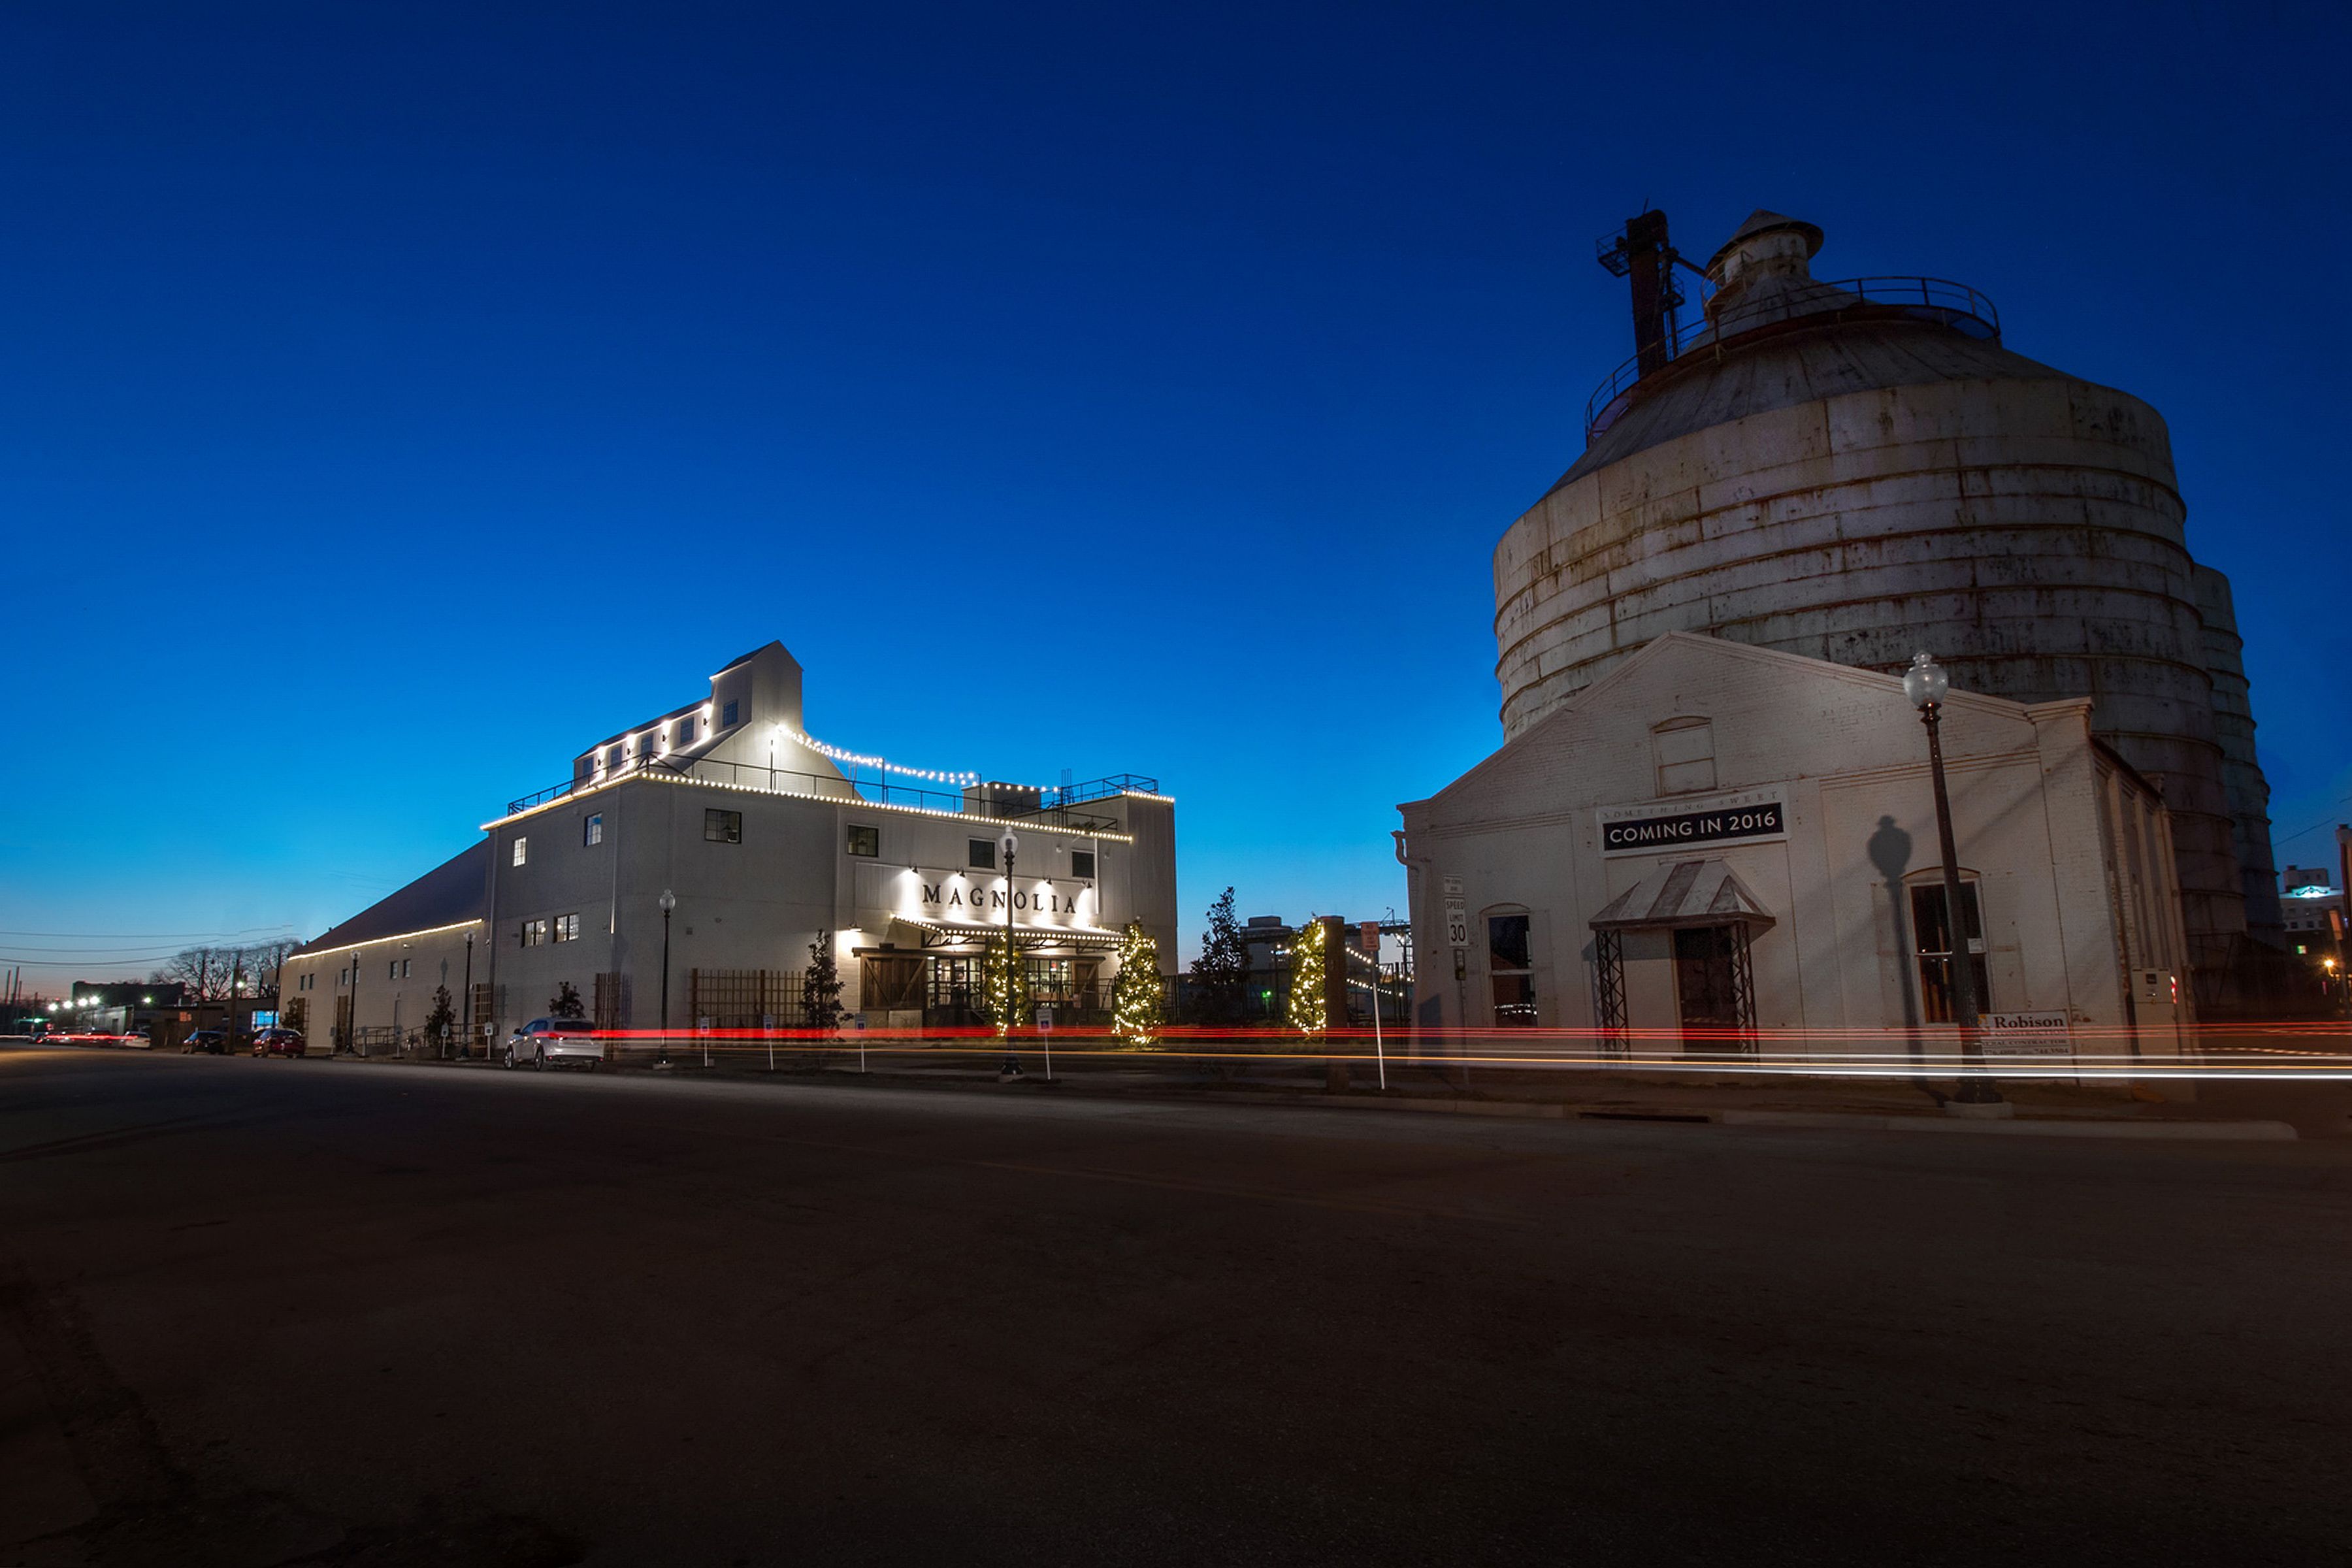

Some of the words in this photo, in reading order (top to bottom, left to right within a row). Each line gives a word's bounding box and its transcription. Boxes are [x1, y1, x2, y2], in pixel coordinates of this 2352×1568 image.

[1604, 804, 1703, 819] SOMETHING
[1719, 791, 1776, 806] SWEET
[1610, 821, 1692, 843] COMING
[1700, 817, 1722, 834] IN
[1728, 811, 1775, 830] 2016
[923, 884, 1076, 914] MAGNOLIA
[1446, 901, 1464, 910] SPEED
[1450, 924, 1465, 941] 30
[1994, 1015, 2064, 1028] Robison
